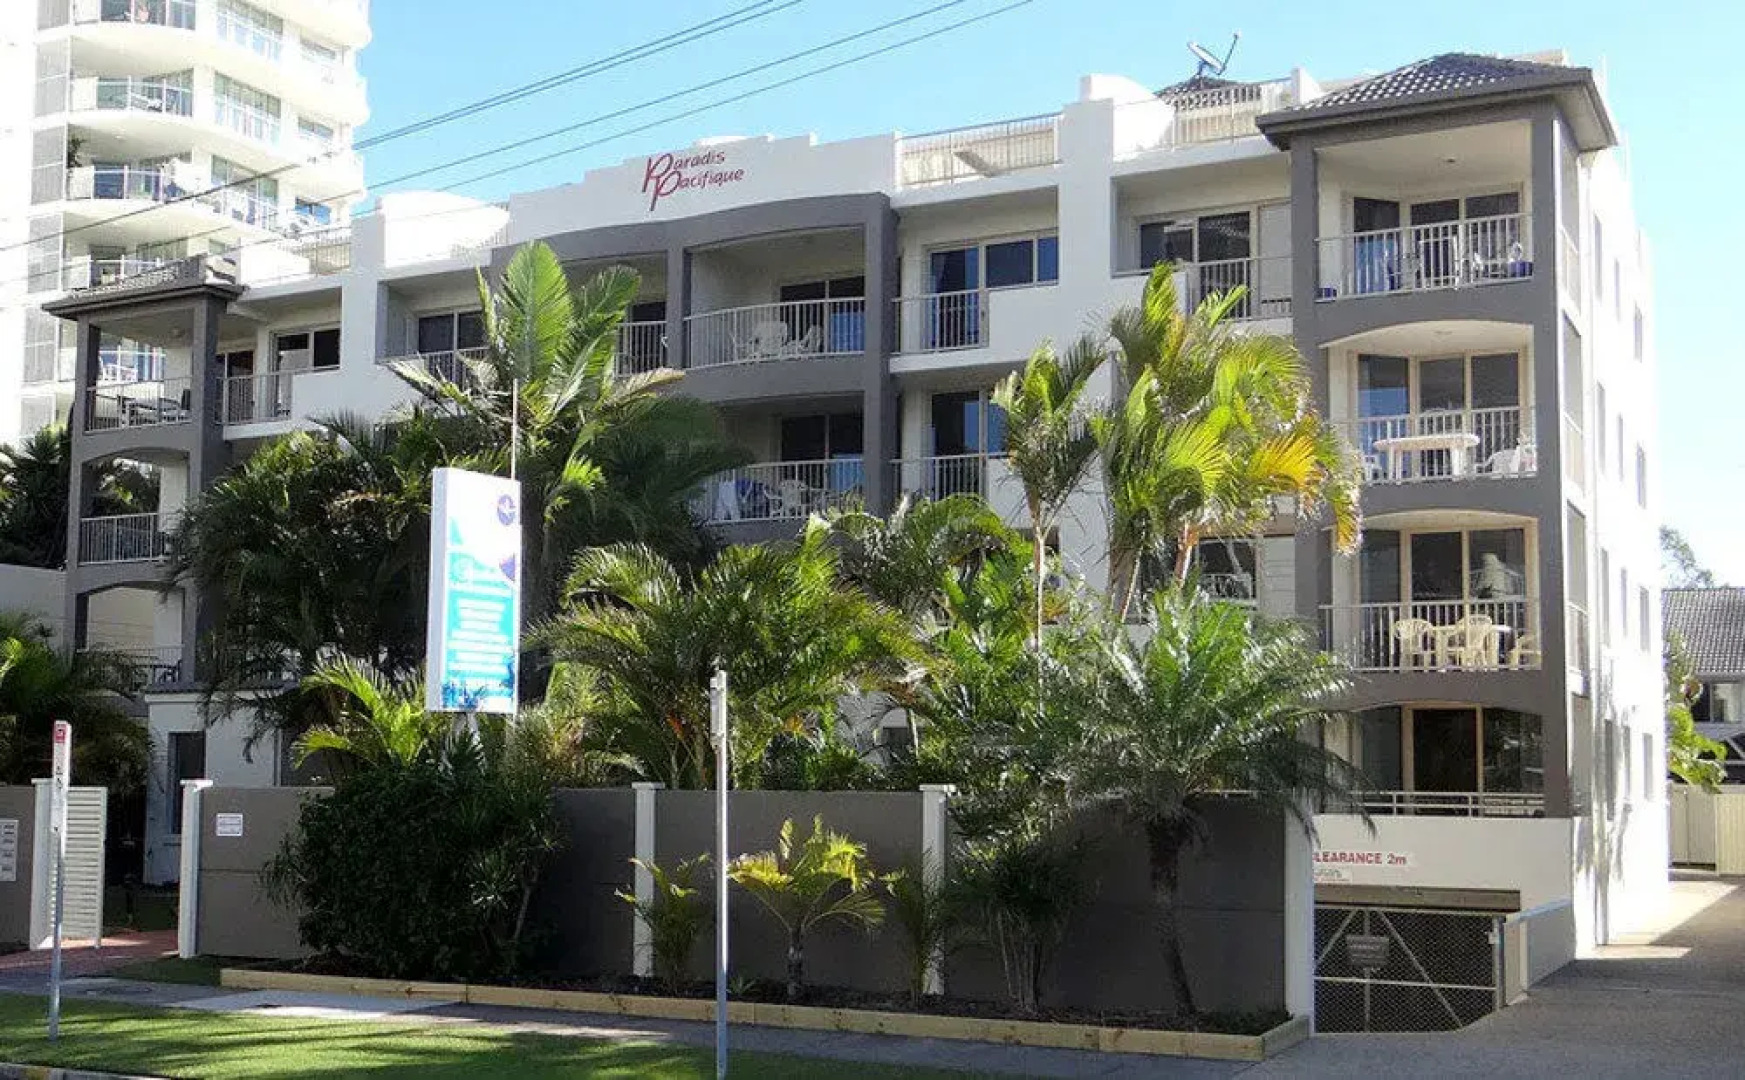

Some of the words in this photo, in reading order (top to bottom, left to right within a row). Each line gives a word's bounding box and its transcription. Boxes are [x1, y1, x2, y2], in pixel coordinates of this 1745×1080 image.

[642, 151, 725, 193] Paradis
[650, 168, 745, 211] Pacifique
[1387, 853, 1408, 865] 2m
